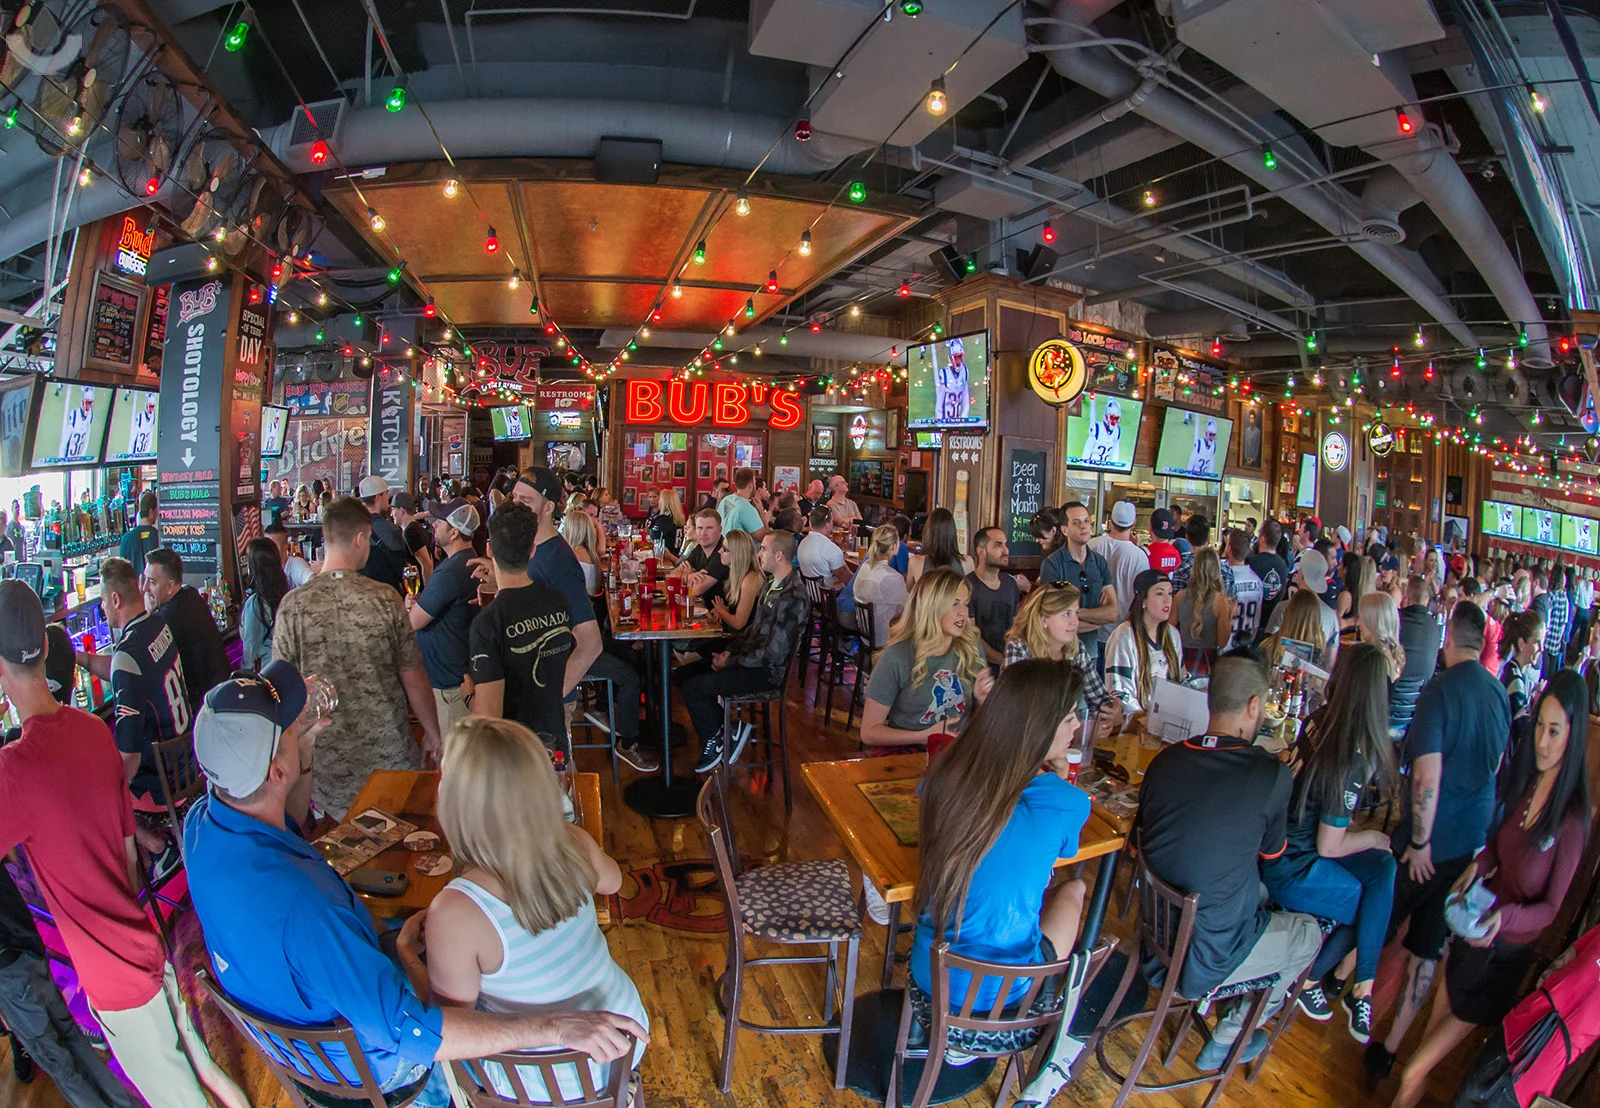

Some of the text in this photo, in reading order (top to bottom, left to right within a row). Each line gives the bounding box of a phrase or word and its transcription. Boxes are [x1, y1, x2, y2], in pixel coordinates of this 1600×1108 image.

[119, 216, 154, 257] Bud
[242, 309, 265, 328] SPECIAL
[240, 335, 262, 364] DAY
[180, 323, 205, 443] SHOTOLOGY
[329, 380, 368, 393] SPORTS
[539, 390, 592, 398] RESTROOMS
[625, 378, 803, 431] BUB'S
[948, 435, 983, 450] RESTROOMS
[1012, 460, 1038, 477] Beer
[1013, 477, 1041, 496] of the
[1011, 495, 1039, 515] Month
[190, 525, 206, 536] KISS
[1161, 557, 1176, 568] BRADY
[505, 611, 570, 638] CORONADO
